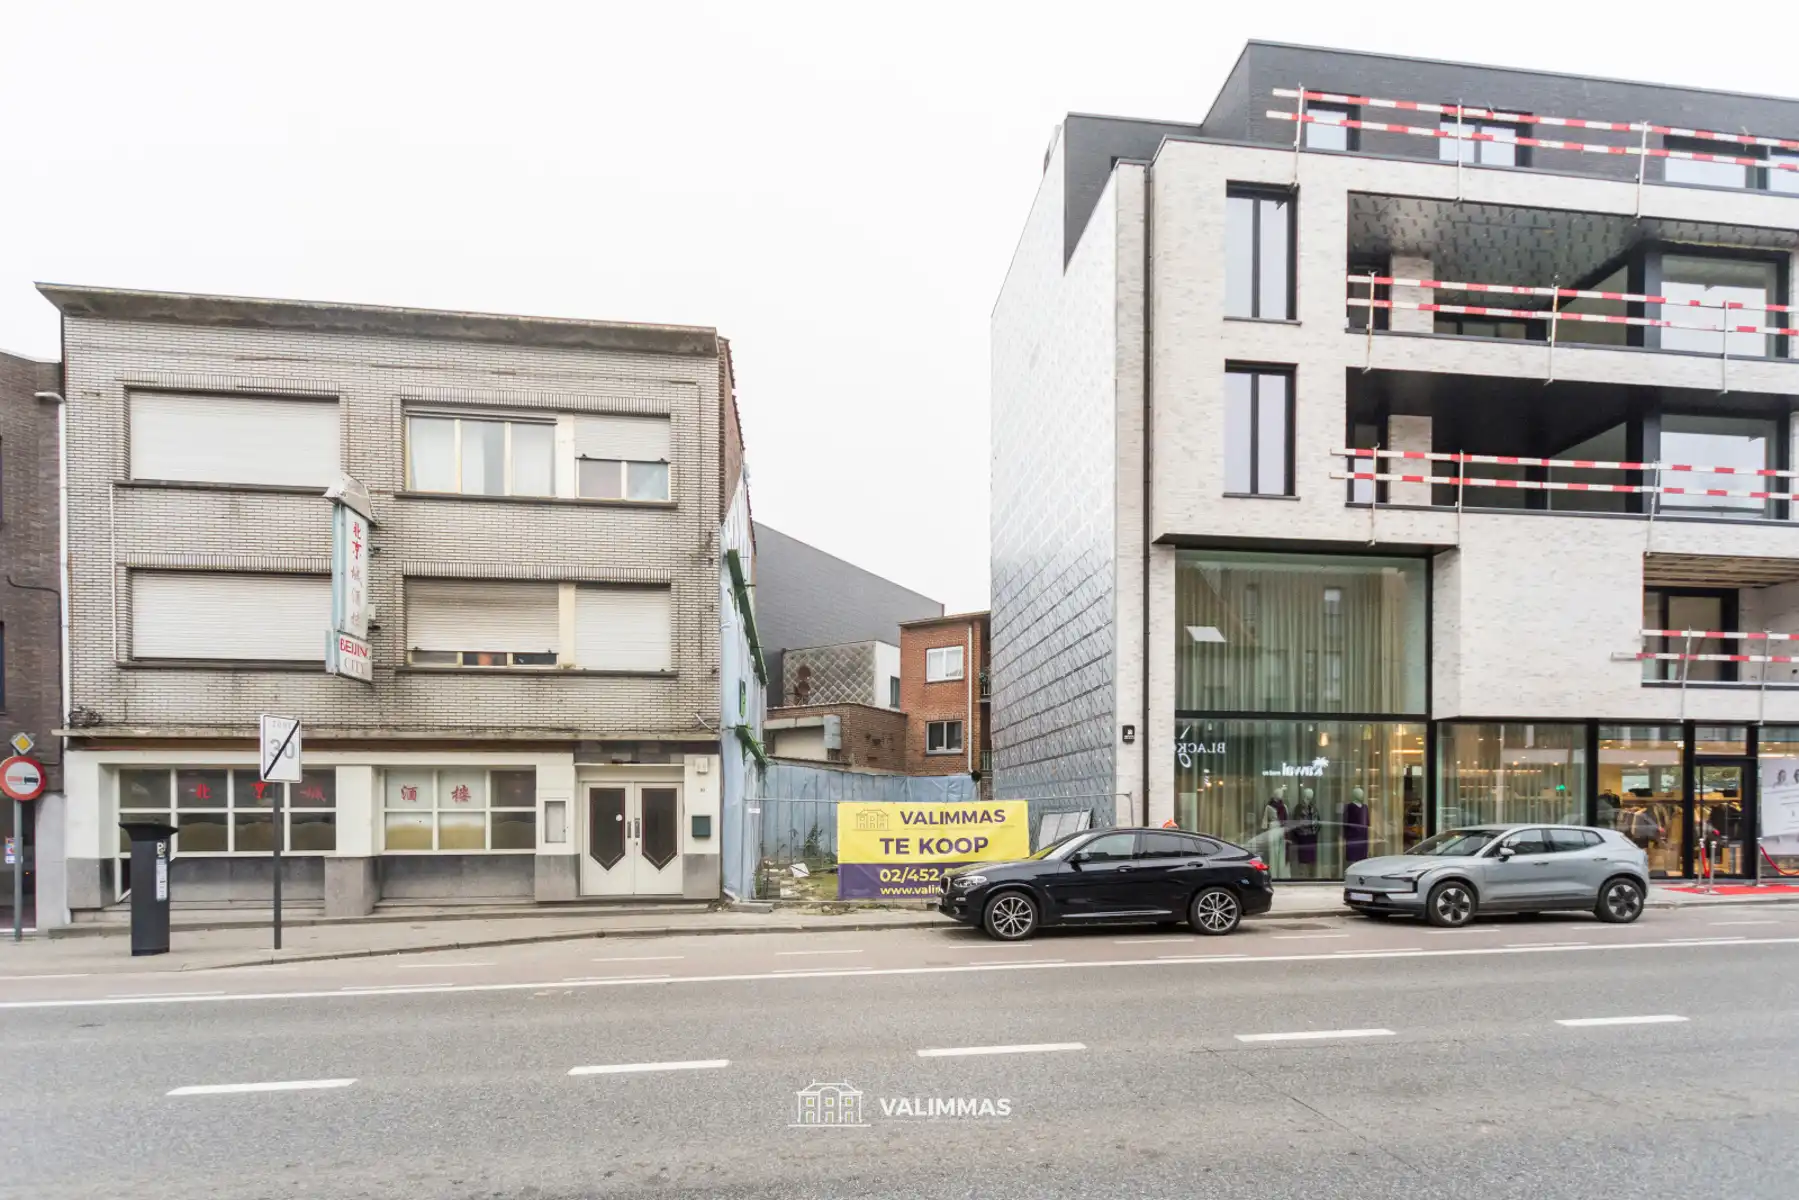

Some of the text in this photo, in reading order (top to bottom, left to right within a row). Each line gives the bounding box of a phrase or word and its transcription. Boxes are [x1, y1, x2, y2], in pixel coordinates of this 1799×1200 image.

[340, 637, 371, 660] BEIJIN
[270, 739, 296, 760] 30
[900, 809, 1006, 825] VALIMMAS
[880, 837, 989, 855] TE KOOP
[879, 866, 940, 884] 02/452
